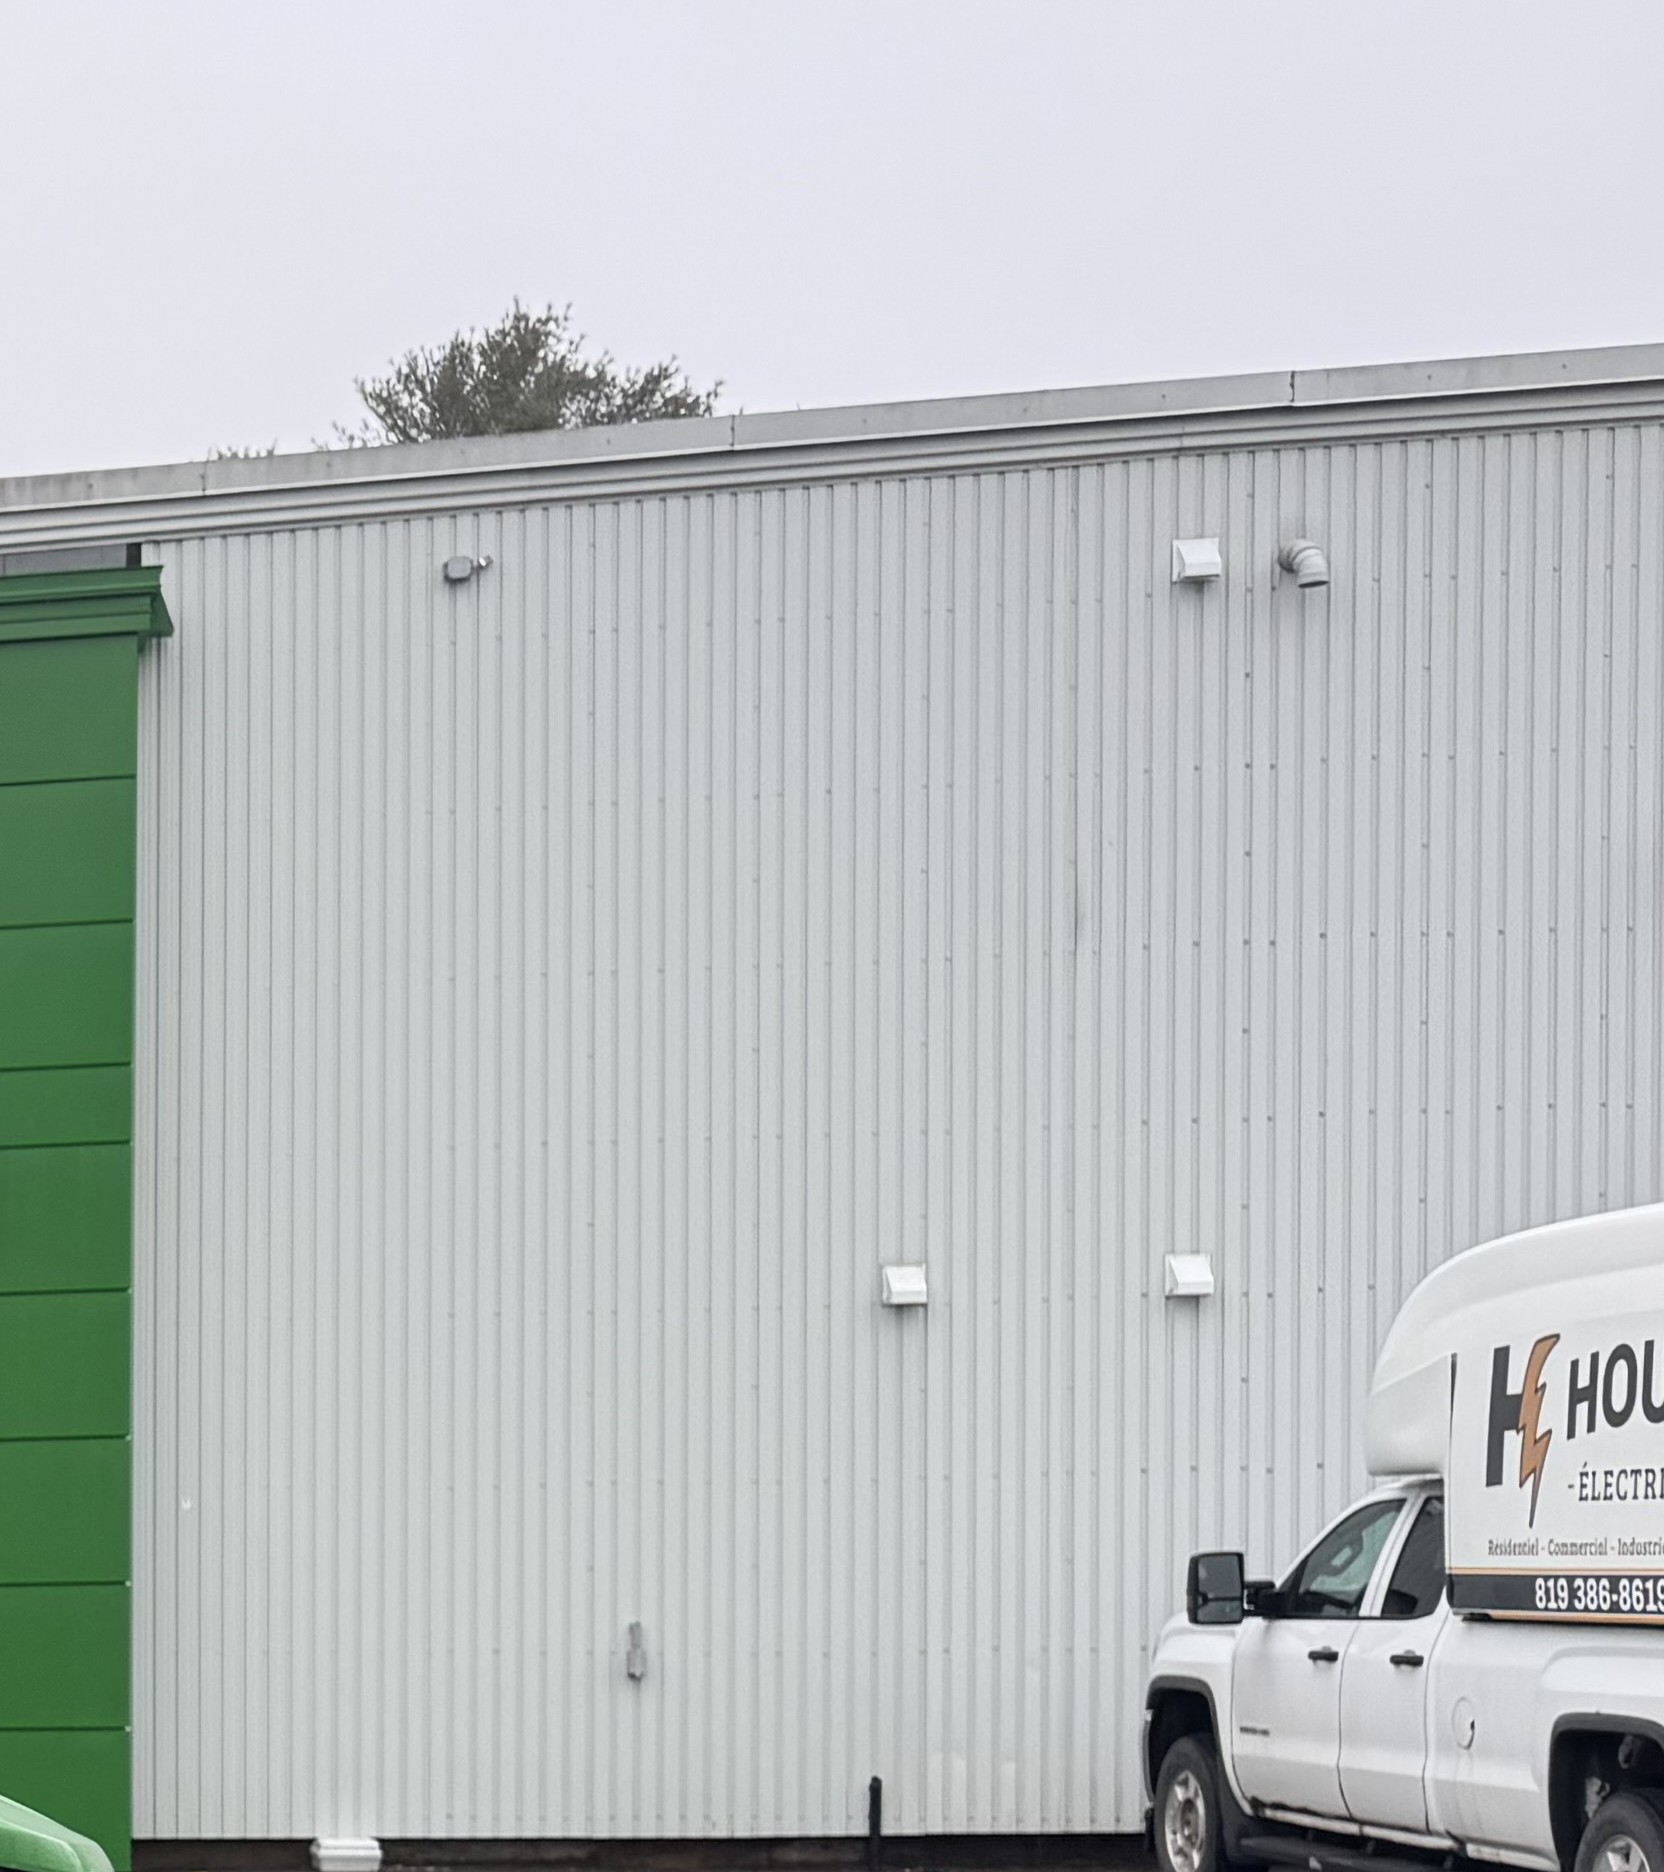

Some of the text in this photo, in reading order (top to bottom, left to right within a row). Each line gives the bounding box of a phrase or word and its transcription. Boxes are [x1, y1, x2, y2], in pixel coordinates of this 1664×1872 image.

[1566, 1339, 1664, 1440] HOU
[1547, 1538, 1608, 1556] Commercial
[1534, 1577, 1568, 1610] 819
